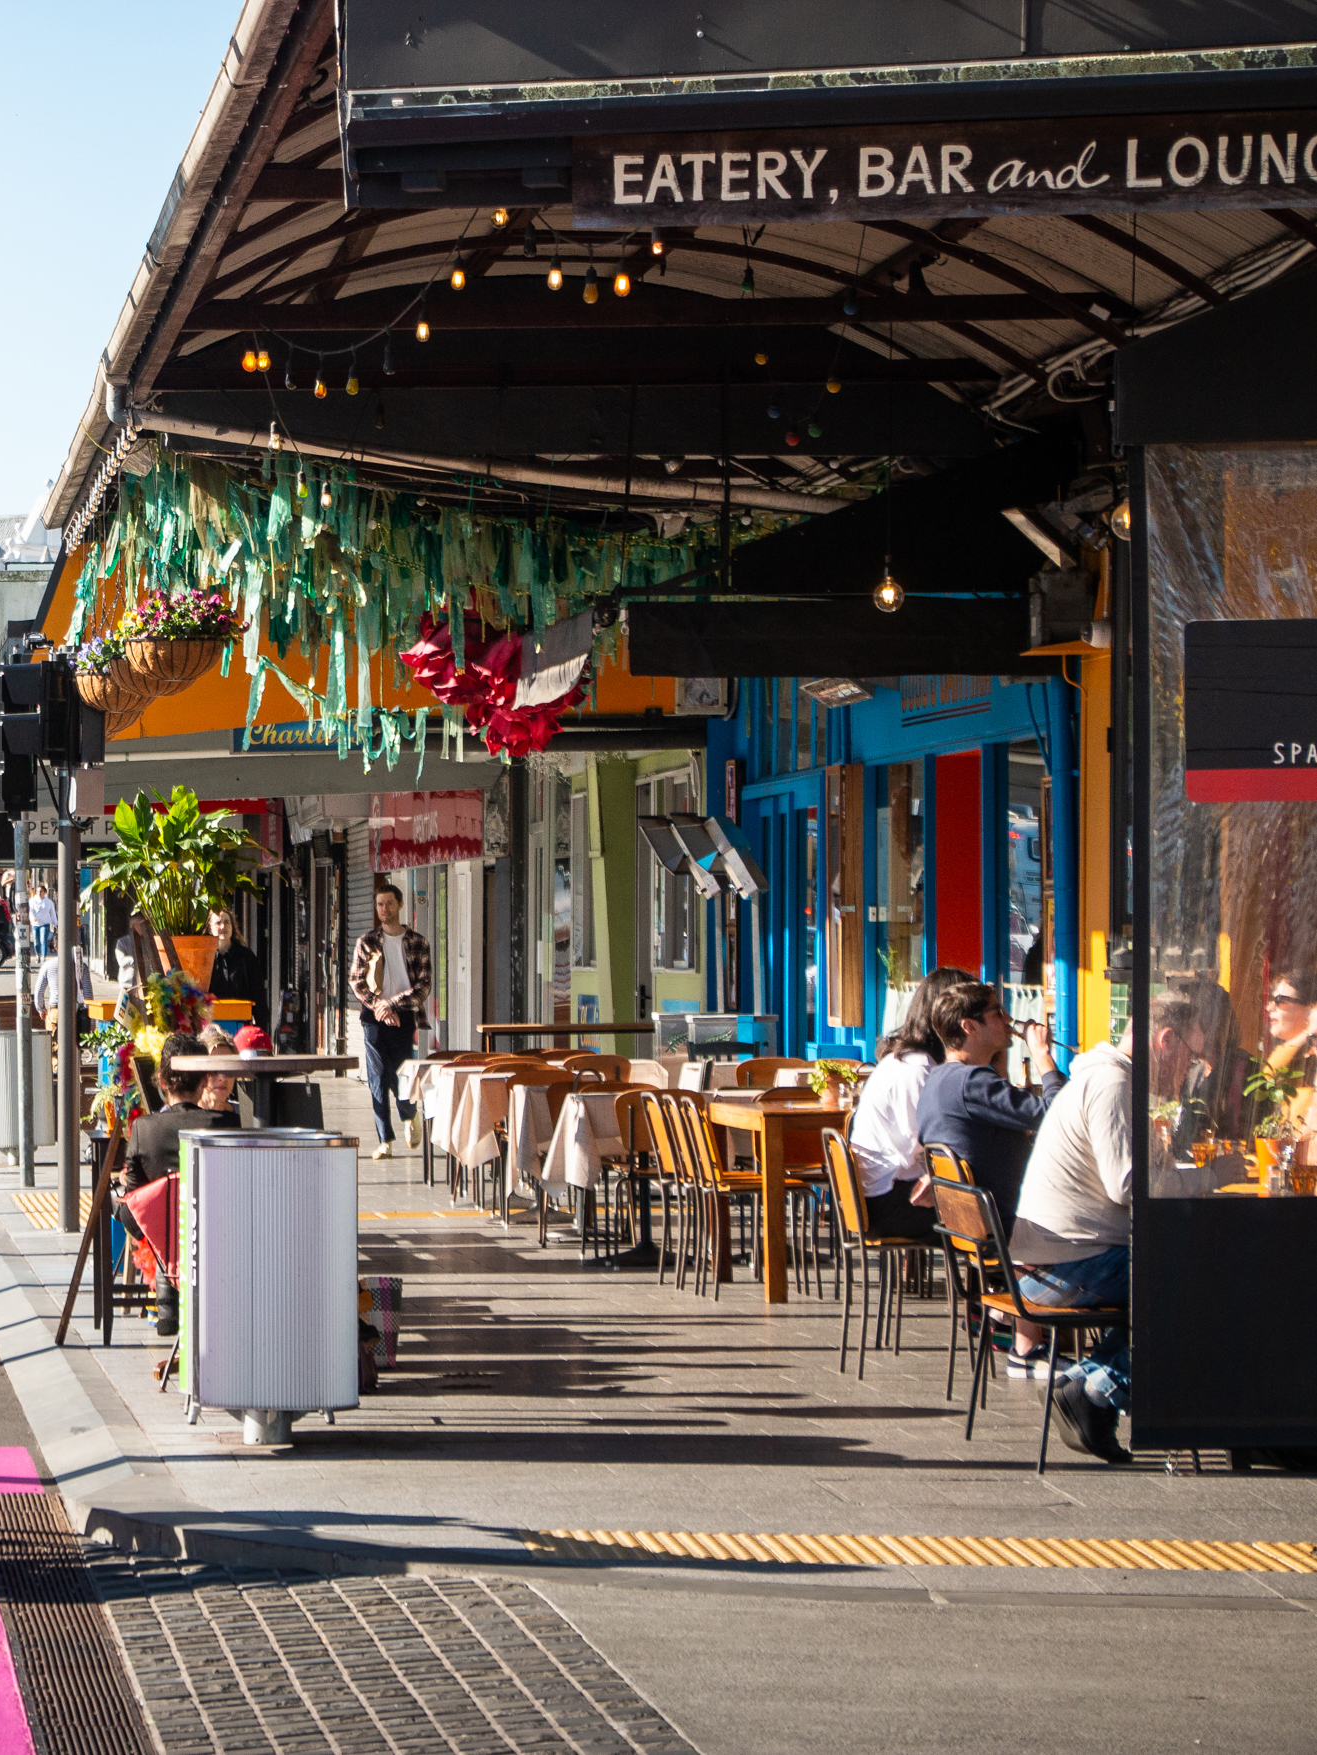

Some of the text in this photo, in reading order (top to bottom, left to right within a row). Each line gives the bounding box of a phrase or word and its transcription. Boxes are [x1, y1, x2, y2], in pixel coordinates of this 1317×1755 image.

[613, 148, 839, 206] EATERY,
[858, 144, 976, 199] BAR
[987, 141, 1110, 193] and
